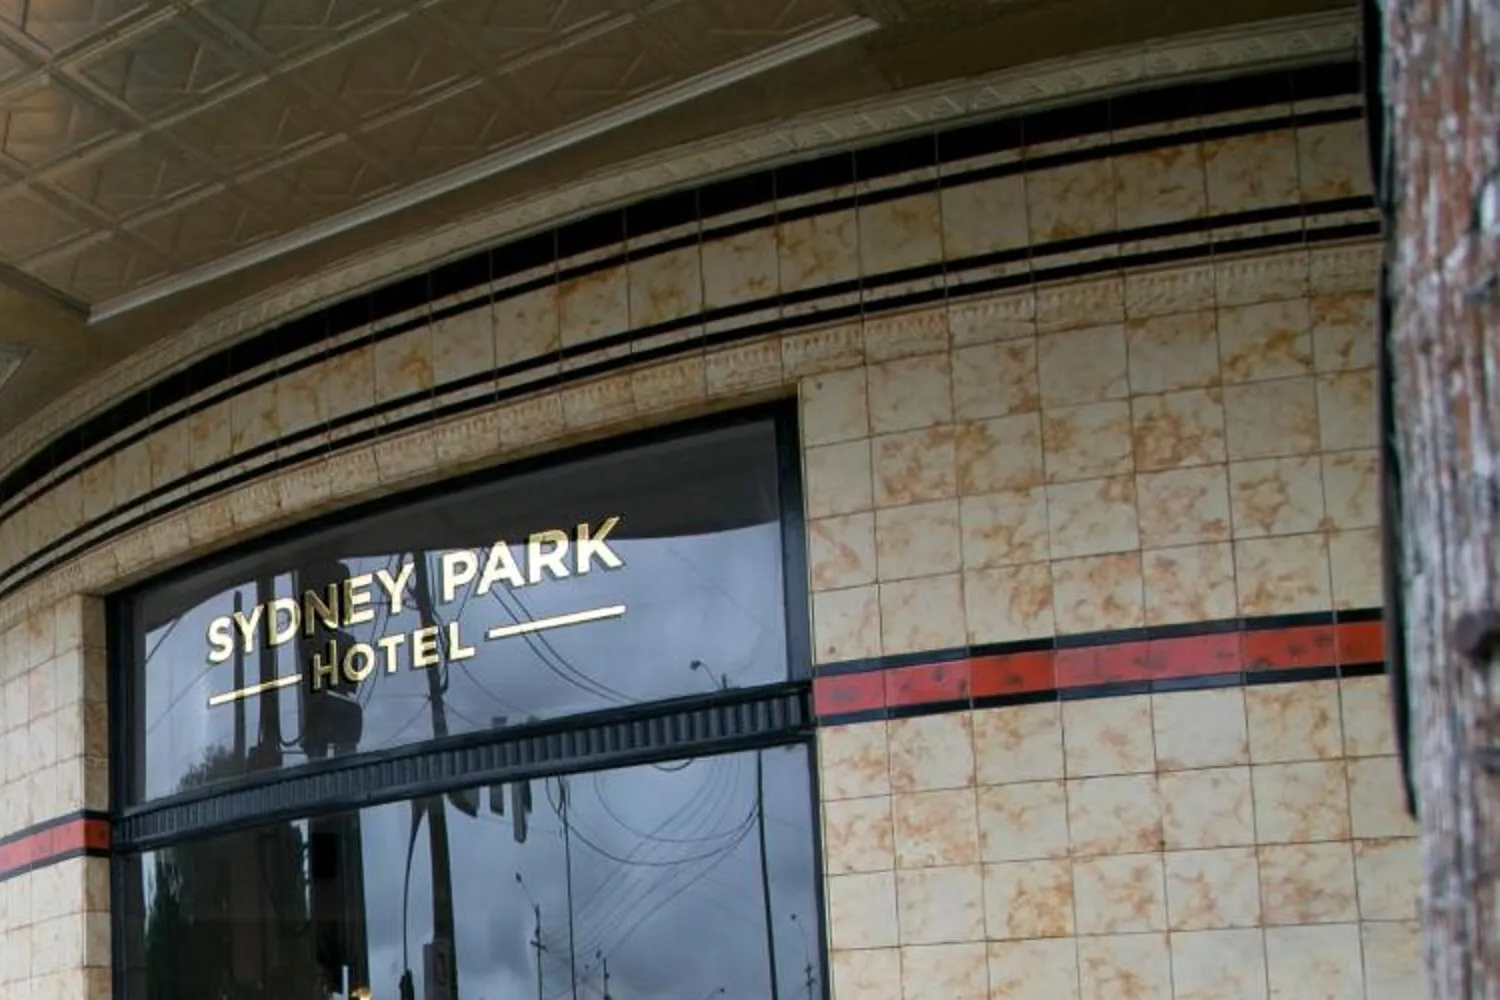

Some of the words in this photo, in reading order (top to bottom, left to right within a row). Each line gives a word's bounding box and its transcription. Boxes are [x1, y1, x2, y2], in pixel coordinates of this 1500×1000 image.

[206, 561, 414, 665] SYDNEY
[439, 515, 623, 603] PARK
[310, 620, 477, 691] HOTEL
